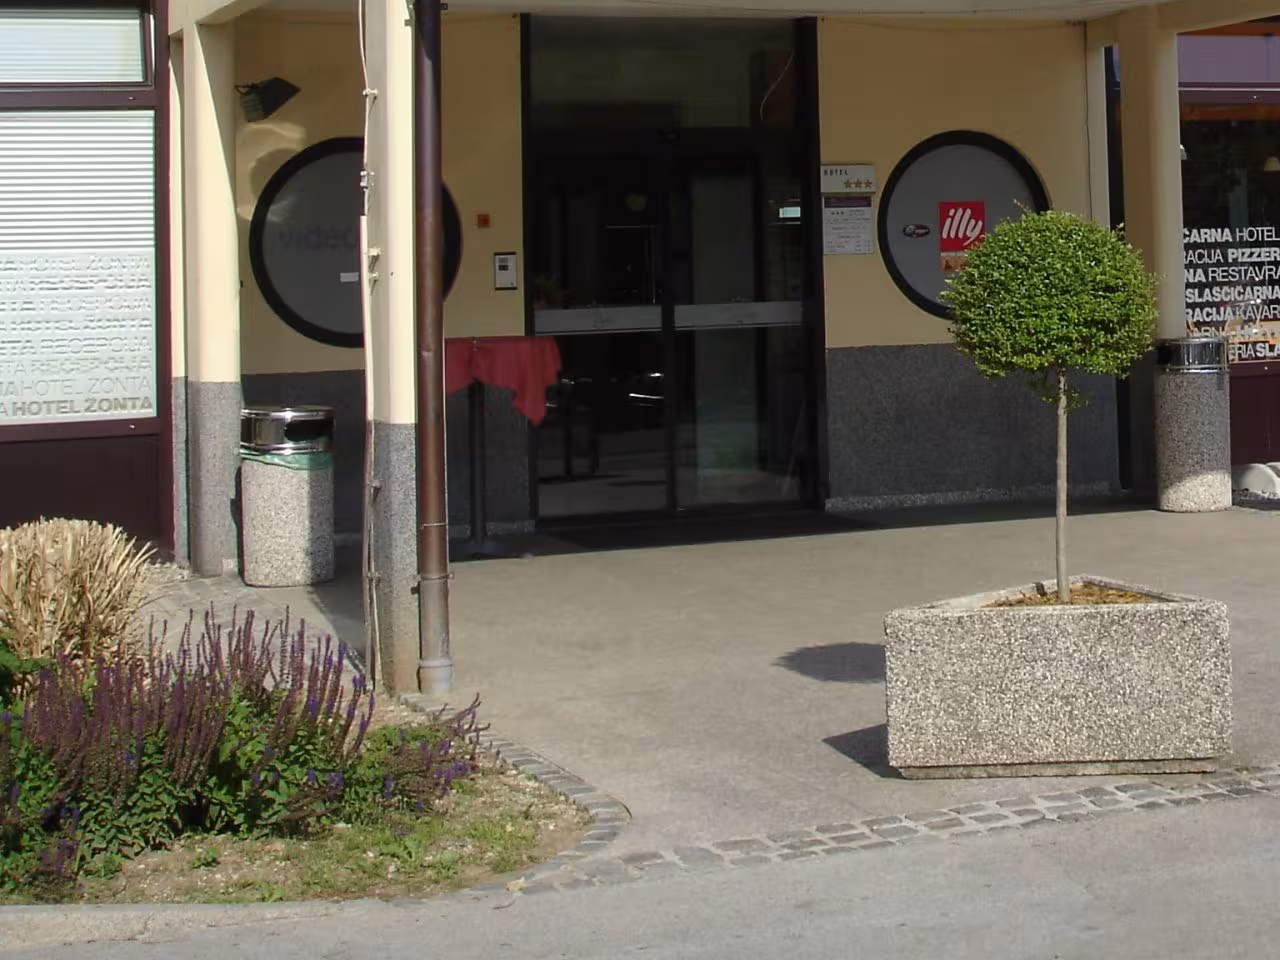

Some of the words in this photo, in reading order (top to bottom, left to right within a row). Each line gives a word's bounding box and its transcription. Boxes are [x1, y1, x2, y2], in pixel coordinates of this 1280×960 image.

[942, 208, 983, 246] illy
[1236, 227, 1280, 241] HOTEL
[21, 379, 83, 397] HOTEL
[12, 399, 81, 417] HOTEL
